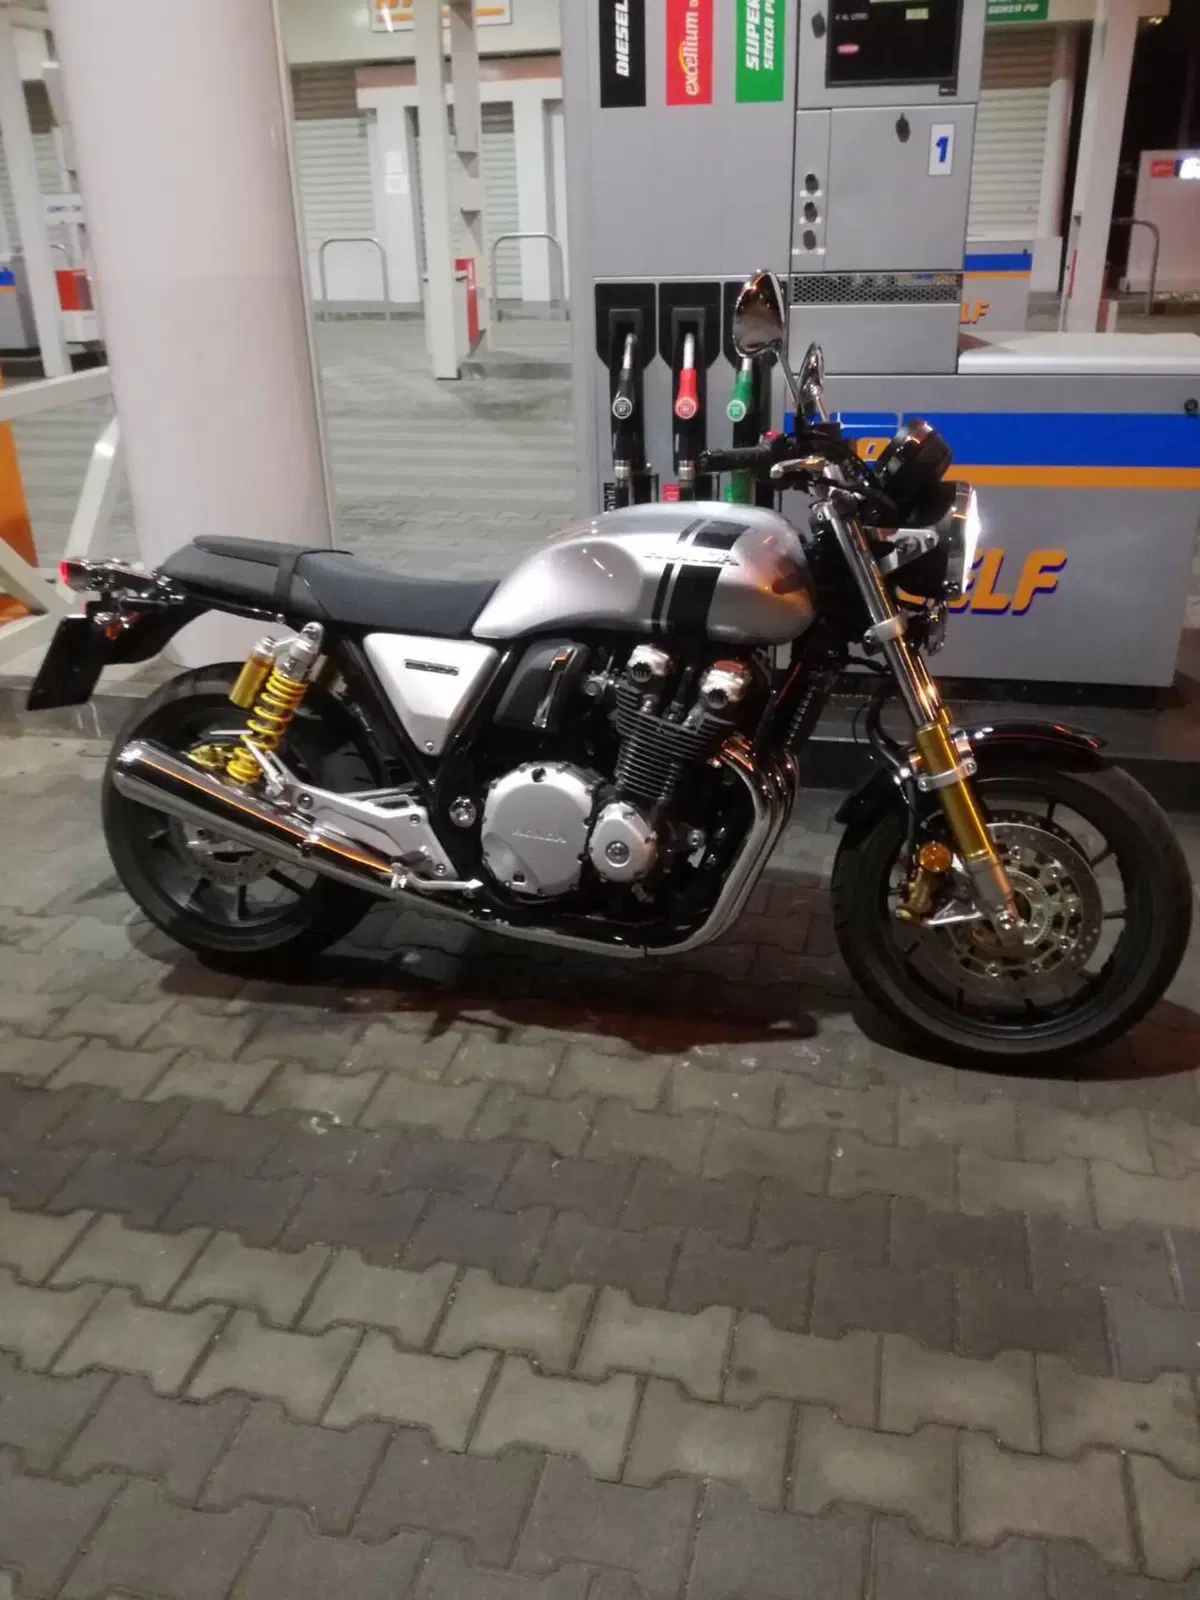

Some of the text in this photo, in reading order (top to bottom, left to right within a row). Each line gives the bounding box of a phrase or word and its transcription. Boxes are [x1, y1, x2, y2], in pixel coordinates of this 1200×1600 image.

[615, 0, 630, 77] DIESEL
[682, 11, 699, 97] excellium
[763, 16, 775, 70] SENZA
[936, 136, 949, 163] 1
